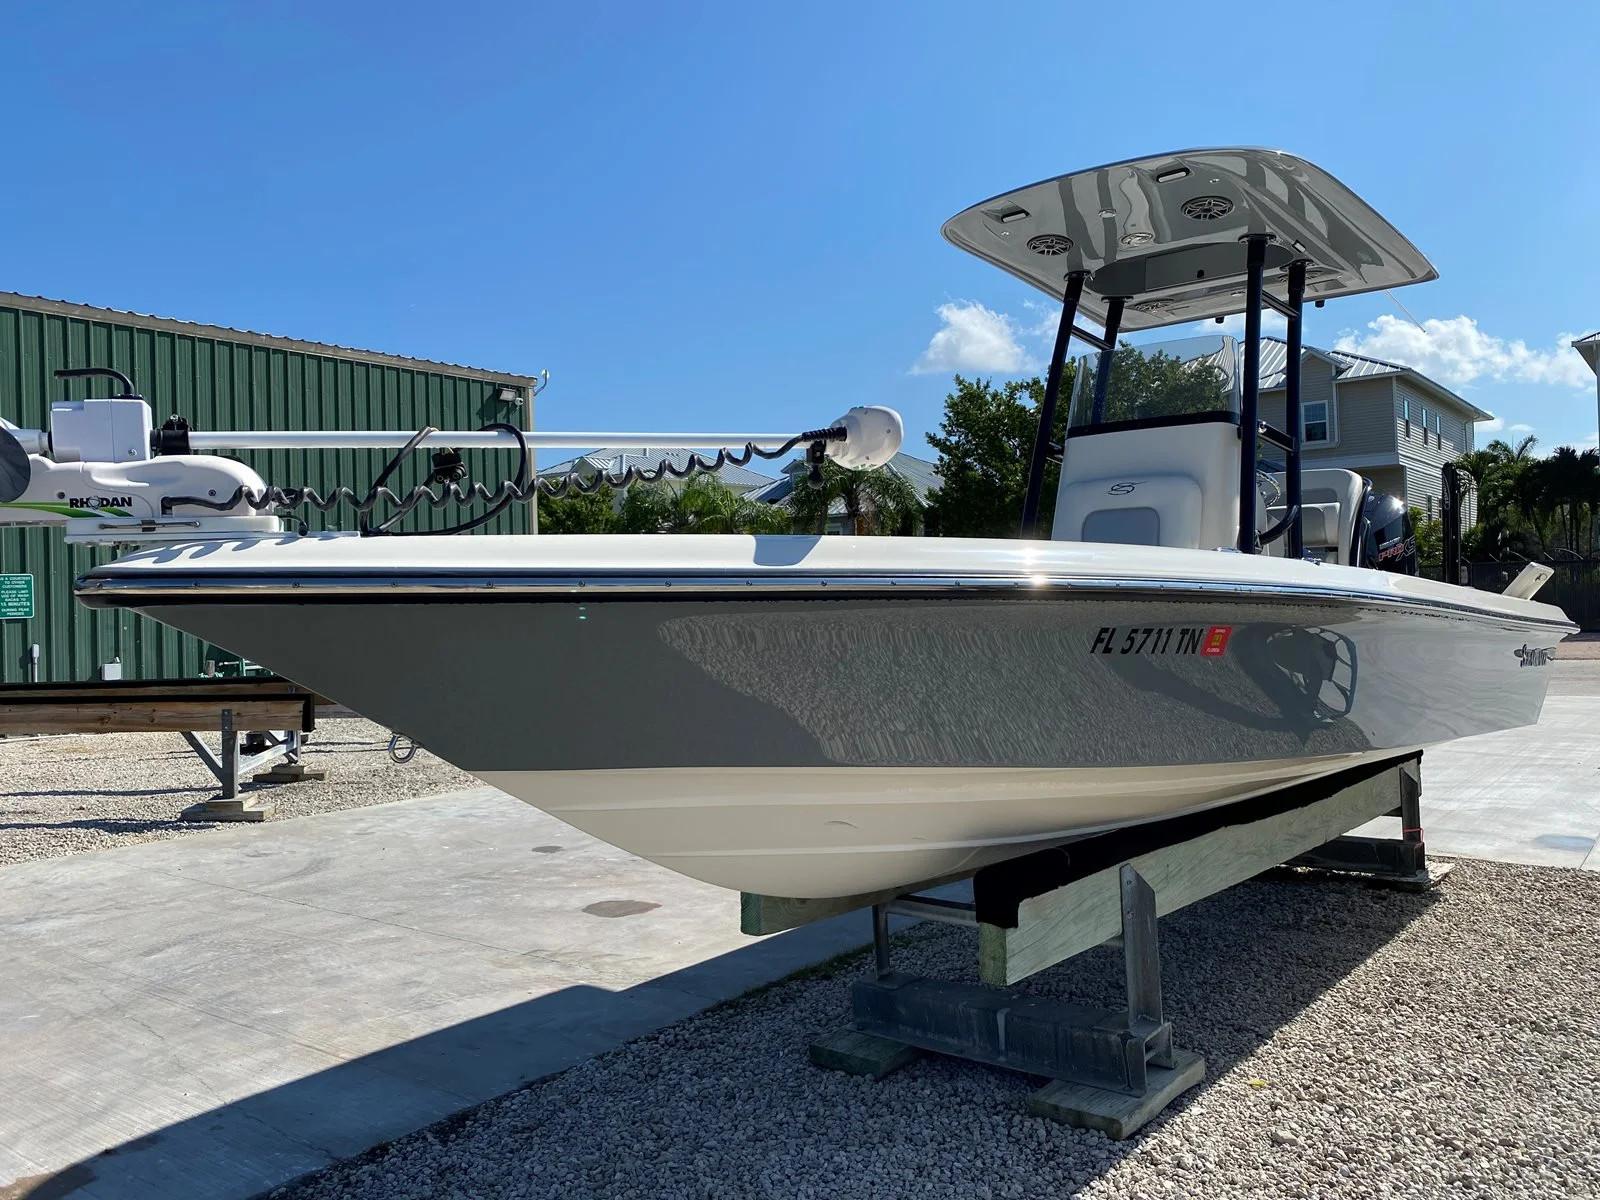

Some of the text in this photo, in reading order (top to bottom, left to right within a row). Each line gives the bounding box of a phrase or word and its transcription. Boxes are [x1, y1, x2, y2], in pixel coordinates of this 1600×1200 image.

[69, 496, 132, 509] RHODAN
[1090, 627, 1117, 654] FL
[1120, 628, 1174, 655] 5711
[1175, 628, 1204, 655] TN
